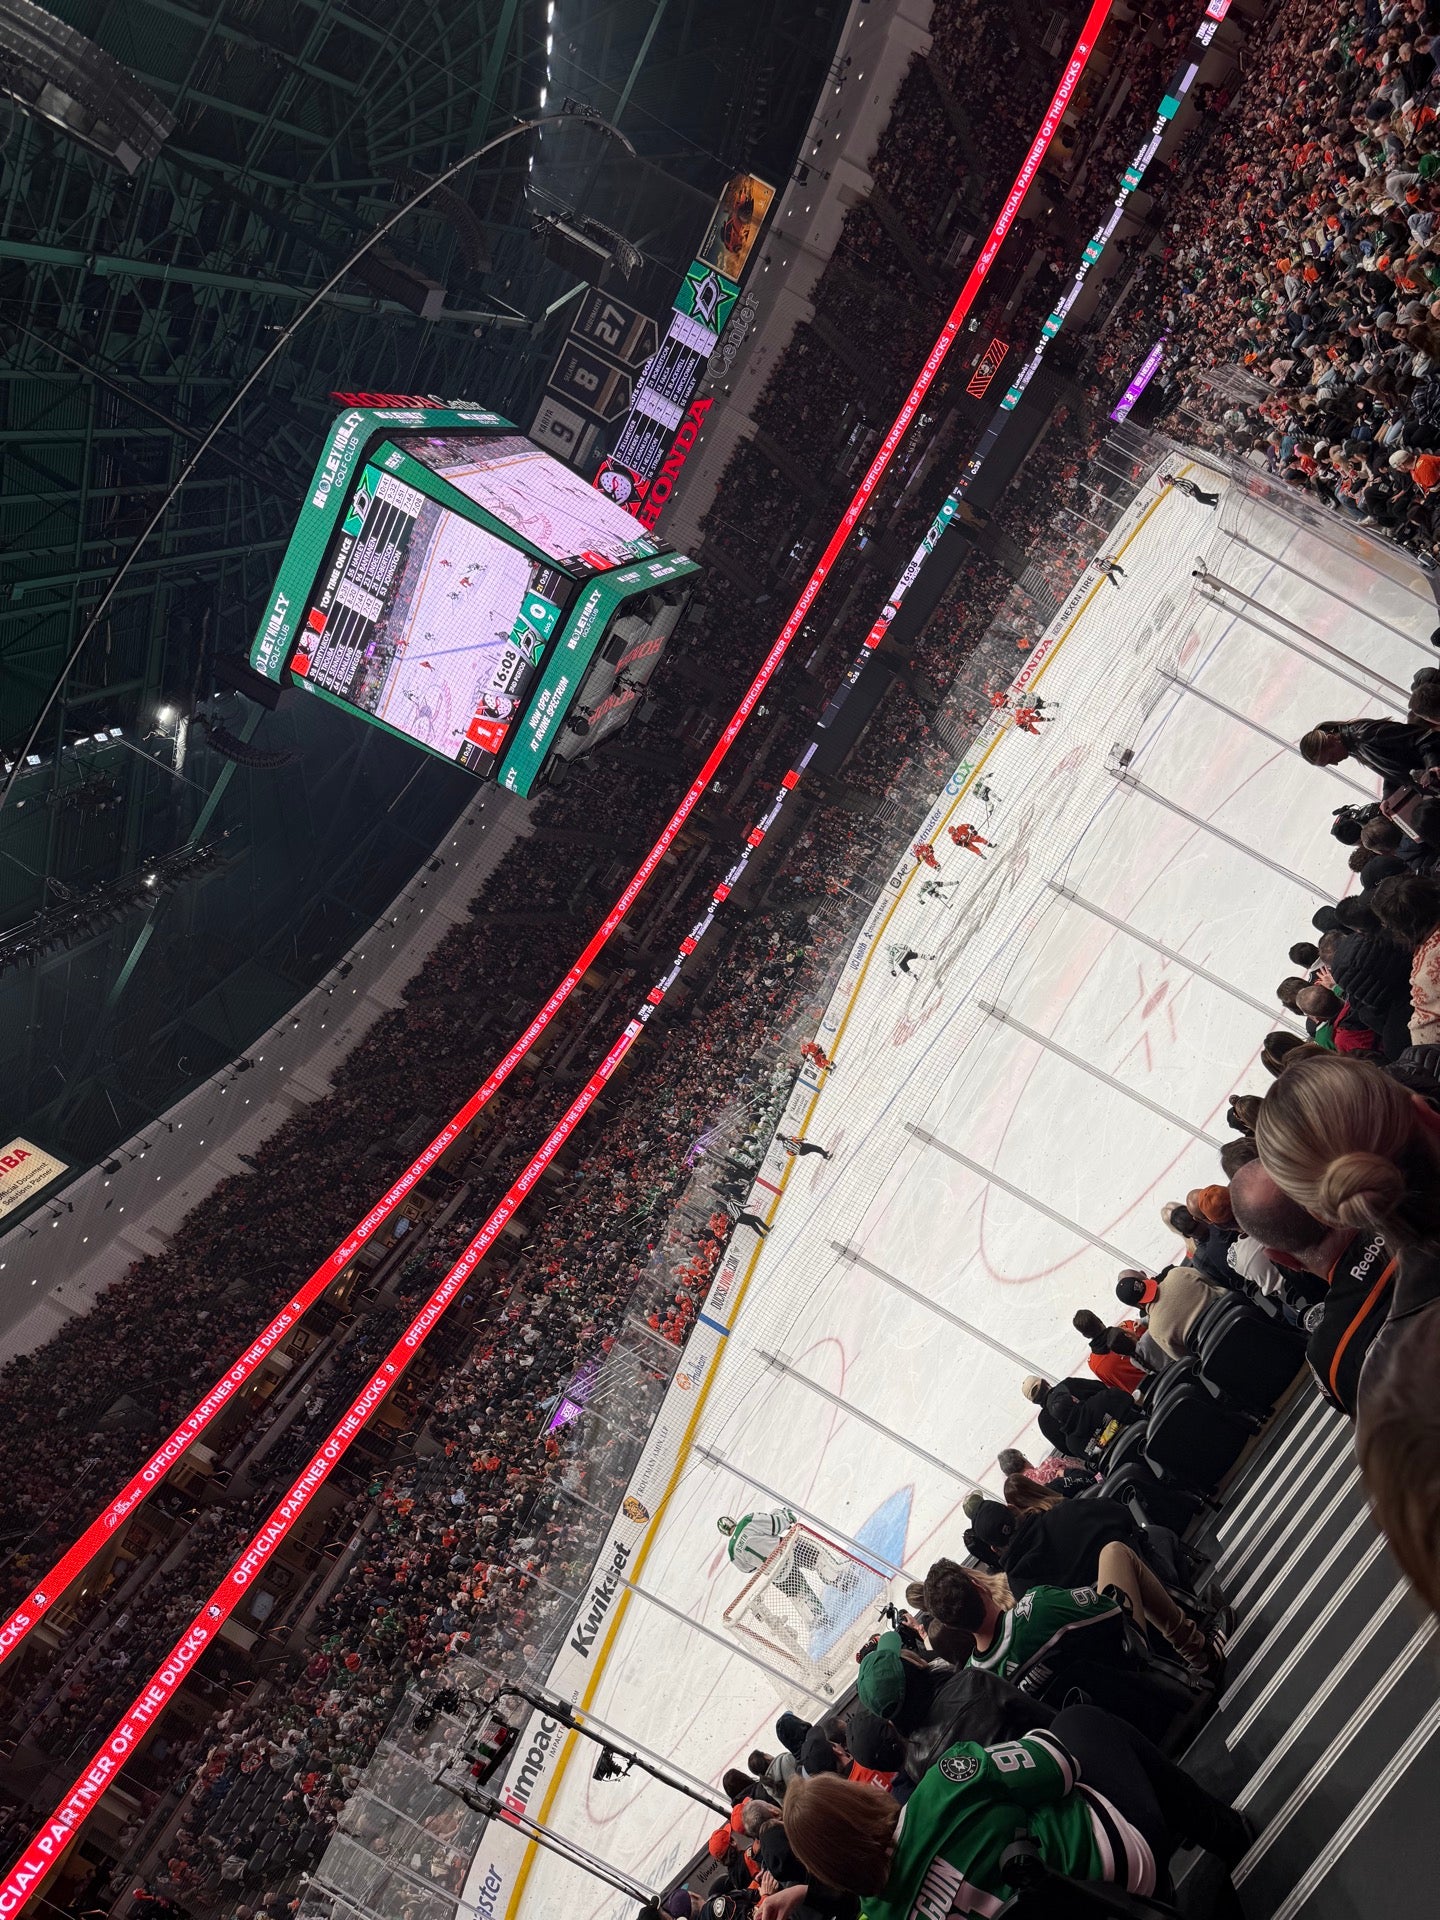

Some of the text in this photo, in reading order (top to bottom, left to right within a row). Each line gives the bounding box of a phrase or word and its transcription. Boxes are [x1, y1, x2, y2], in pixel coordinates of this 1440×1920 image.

[1195, 21, 1209, 39] TIME
[1200, 33, 1212, 46] ON
[1206, 20, 1218, 35] ICE
[1152, 114, 1167, 135] 0:16
[995, 60, 1082, 235] OFFICIAL PARTNER OF THE DUCKS
[1131, 144, 1148, 168] Johnston
[1114, 187, 1129, 208] 0:16
[1074, 260, 1089, 281] 0:16
[1052, 296, 1066, 315] Lindell
[595, 306, 626, 342] 27
[1034, 334, 1049, 354] 0:16
[651, 346, 670, 378] ROBERTSON
[659, 365, 671, 384] FAKSA
[667, 358, 685, 388] BLACKWELL
[574, 368, 599, 390] 8
[635, 375, 645, 388] ON
[683, 376, 696, 398] HARLEY
[331, 391, 443, 409] HONDA
[637, 292, 761, 529] HONDA Center
[863, 336, 950, 491] OFFICIAL PARTNER OF THE DUCKS
[537, 409, 555, 433] KARIYA
[550, 421, 575, 443] 9
[334, 437, 358, 486] GOLF CLUB
[970, 458, 982, 475] 0:39
[351, 542, 365, 566] HARLEY
[378, 477, 389, 496] 10:41
[943, 505, 953, 514] 0
[375, 492, 413, 580] ROBERTSON 7:46
[359, 537, 376, 570] RANTANEN
[367, 551, 381, 575] LINDELL
[383, 550, 401, 585] JOHNSTON
[320, 536, 352, 608] TOP TIME ON ICE
[539, 569, 550, 584] 0:39
[899, 561, 918, 585] 16:08
[528, 603, 546, 619] 0
[1059, 574, 1094, 620] NEXEN TIRE
[582, 608, 598, 637] GOLF CLUB
[870, 632, 879, 640] 1
[268, 623, 290, 668] GOLF CLUB
[740, 580, 819, 714] OFFICIAL PARTNER OF THE DUCKS
[336, 647, 353, 679] GRANLUND
[344, 649, 363, 683] ZELLWEGER
[492, 650, 516, 688] 16:08
[508, 661, 526, 693] 2ND PERIOD
[1012, 636, 1053, 692] HONDA
[528, 688, 552, 728] NOW OPEN
[528, 676, 569, 752] AT IRVINE SPECTRUM
[475, 725, 491, 738] 1
[945, 759, 974, 796] COX
[775, 786, 788, 802] 0:21
[618, 790, 698, 910] OFFICIAL PARTNER OF THE DUCKS
[741, 842, 753, 859] 0:16
[707, 898, 719, 913] 0:16
[673, 950, 686, 966] 0:16
[848, 940, 869, 971] UCI Health
[495, 976, 575, 1079] OFFICIAL PARTNER OF THE DUCKS
[517, 1090, 593, 1191] OFFICIAL PARTNER OF THE DUCKS
[3, 1167, 53, 1206] Solutions Partner
[17, 1162, 46, 1186] Document
[357, 1130, 453, 1237] OFFICIAL PARTNER OF THE DUCKS
[405, 1206, 509, 1346] OFFICIAL PARTNER OF THE DUCKS
[711, 1255, 739, 1309] DUCKSLIVING.COM
[142, 1313, 292, 1482] OFFICIAL PARTNER OF THE DUCKS
[232, 1377, 386, 1585] OFFICIAL PARTNER OF THE DUCKS
[635, 1459, 658, 1497] TROUTMAN
[744, 1543, 767, 1564] 1
[567, 1541, 631, 1656] Kwikset
[39, 1627, 206, 1854] PARTNER OF THE DUCKS
